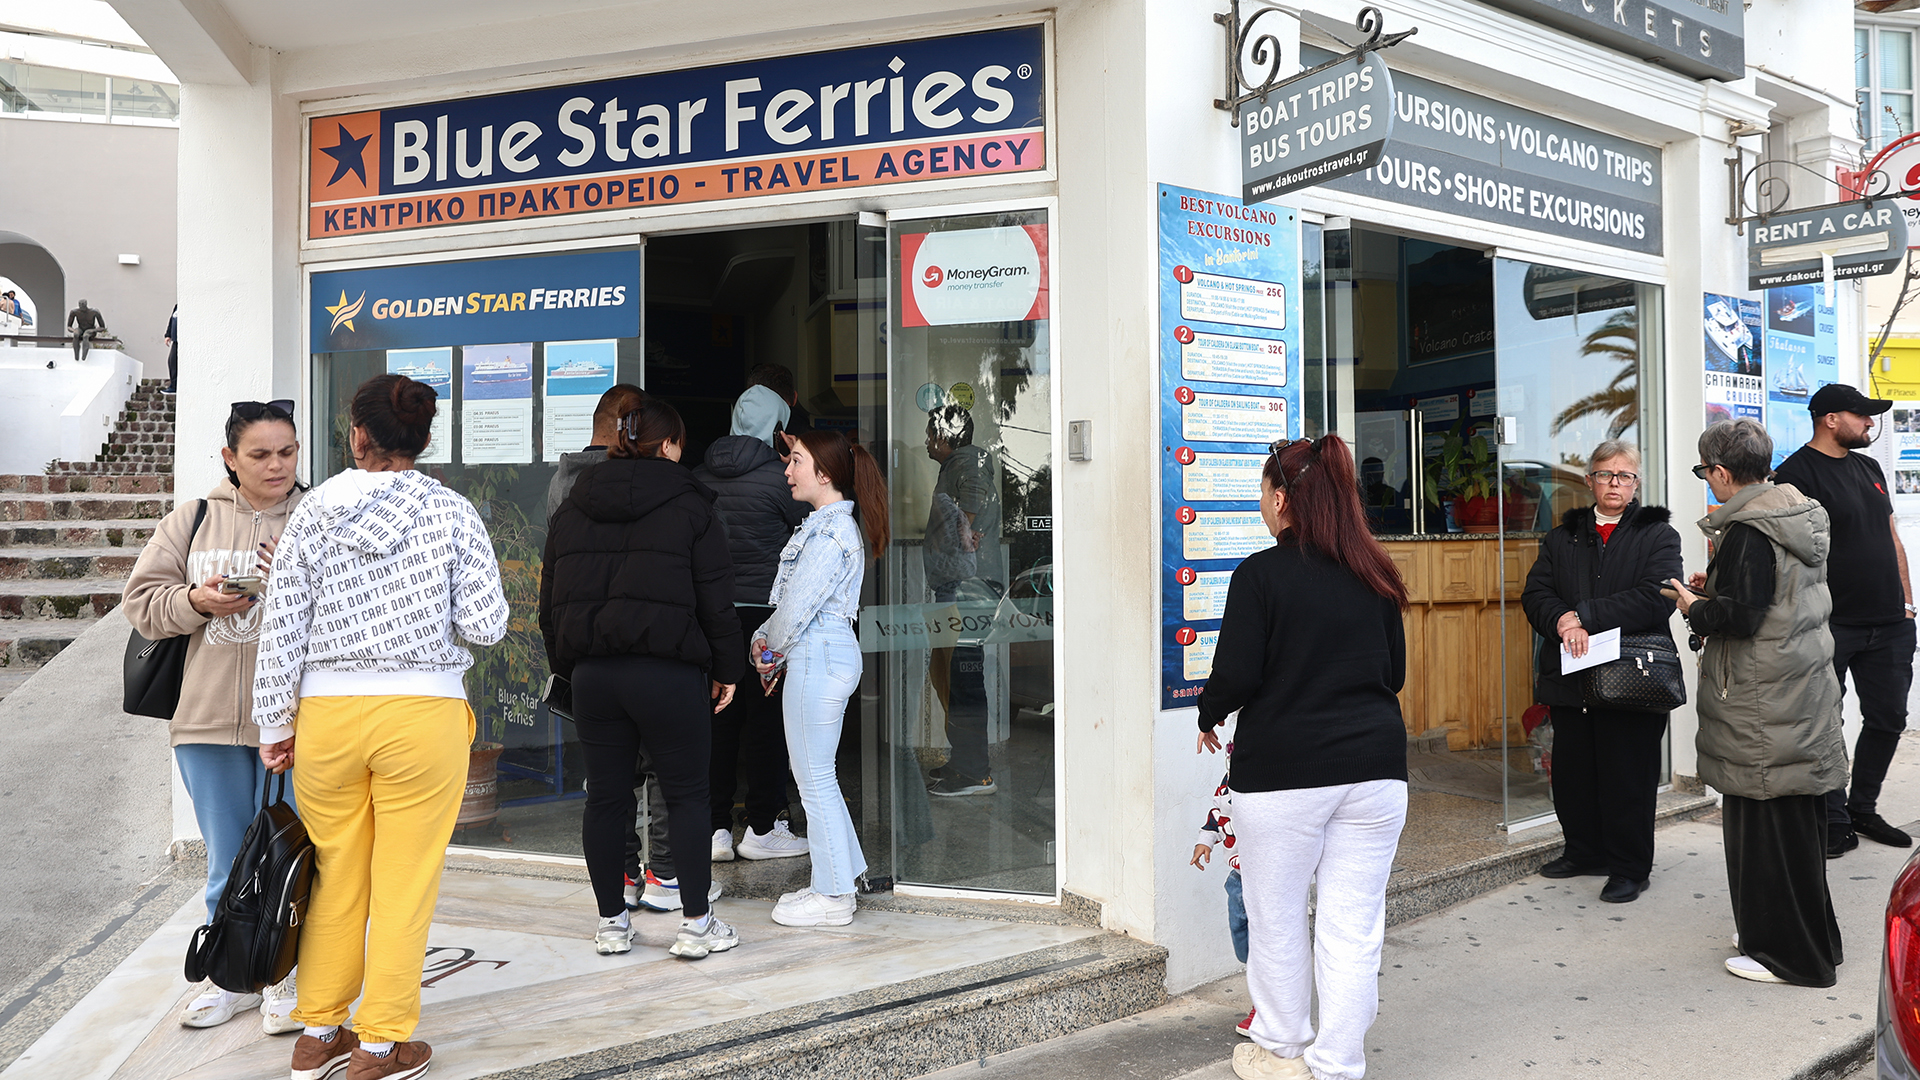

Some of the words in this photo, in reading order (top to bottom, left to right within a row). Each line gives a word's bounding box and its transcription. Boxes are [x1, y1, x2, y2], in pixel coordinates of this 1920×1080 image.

[1246, 92, 1302, 136] BOAT
[1307, 65, 1374, 111] TRIPS
[393, 117, 542, 186] Blue
[557, 95, 708, 168] Star
[1249, 133, 1291, 169] BUS
[1296, 104, 1372, 151] TOURS
[1506, 121, 1599, 172] VOLCANO
[1603, 148, 1653, 187] TRIPS
[721, 156, 860, 194] TRAVEL
[874, 138, 1031, 180] AGENCY
[1251, 149, 1368, 196] www.dakoutrostravel.gr
[324, 196, 465, 232] ΚΕΝΤΡΙΚΟ
[478, 174, 680, 218] ΠΡΑΚΤΟΡΕΙΟ
[1180, 195, 1213, 215] BEST
[1216, 202, 1277, 226] VOLCANO
[1454, 172, 1525, 215] SHORE
[1529, 189, 1646, 241] EXCURSIONS
[1187, 220, 1271, 247] EXCURSIONS
[1754, 220, 1813, 244] RENT
[1819, 217, 1837, 235] A
[1842, 208, 1892, 231] CAR
[1204, 253, 1214, 266] in
[1180, 266, 1186, 281] 1
[1759, 263, 1885, 285] www.dakoutrstravel.gr
[947, 282, 972, 291] money
[973, 280, 1004, 290] transfer
[1197, 278, 1220, 290] VOLCANO
[1225, 282, 1235, 290] HOT
[1236, 283, 1256, 294] SPRINGS
[1267, 287, 1282, 298] 25€
[1180, 327, 1188, 341] 2
[1419, 337, 1457, 353] Volcano
[1462, 330, 1495, 345] Crate
[1268, 345, 1283, 354] 32€
[1817, 355, 1835, 366] SUNSET
[1706, 373, 1762, 390] CATAMARAN
[1181, 388, 1188, 402] 3
[1726, 390, 1762, 404] CRUISES
[1893, 388, 1917, 396] Piraeus
[1268, 402, 1283, 412] 30€
[1181, 448, 1189, 462] 4
[1181, 507, 1189, 522] 5
[422, 527, 448, 545] CARE
[325, 558, 357, 578] DON'T
[337, 574, 366, 593] CARE
[368, 561, 400, 582] DON'T
[402, 551, 428, 570] CARE
[1181, 568, 1190, 583] 6
[318, 600, 344, 617] CARE
[347, 587, 380, 608] DON'T
[382, 577, 407, 596] CARE
[410, 565, 441, 585] DON'T
[474, 587, 500, 612] DON'T
[327, 613, 359, 633] DON'T
[361, 602, 389, 622] CARE
[391, 591, 422, 611] DON'T
[276, 628, 303, 648] CARE
[312, 638, 338, 655] DON'T
[340, 629, 368, 648] CARE
[371, 616, 403, 637] DON'T
[404, 606, 432, 626] CARE
[1182, 629, 1190, 643] 7
[1200, 635, 1219, 645] SUNS
[384, 632, 412, 652] CARE
[272, 666, 299, 687] DON'T
[498, 688, 518, 706] Blue
[520, 692, 539, 710] Star
